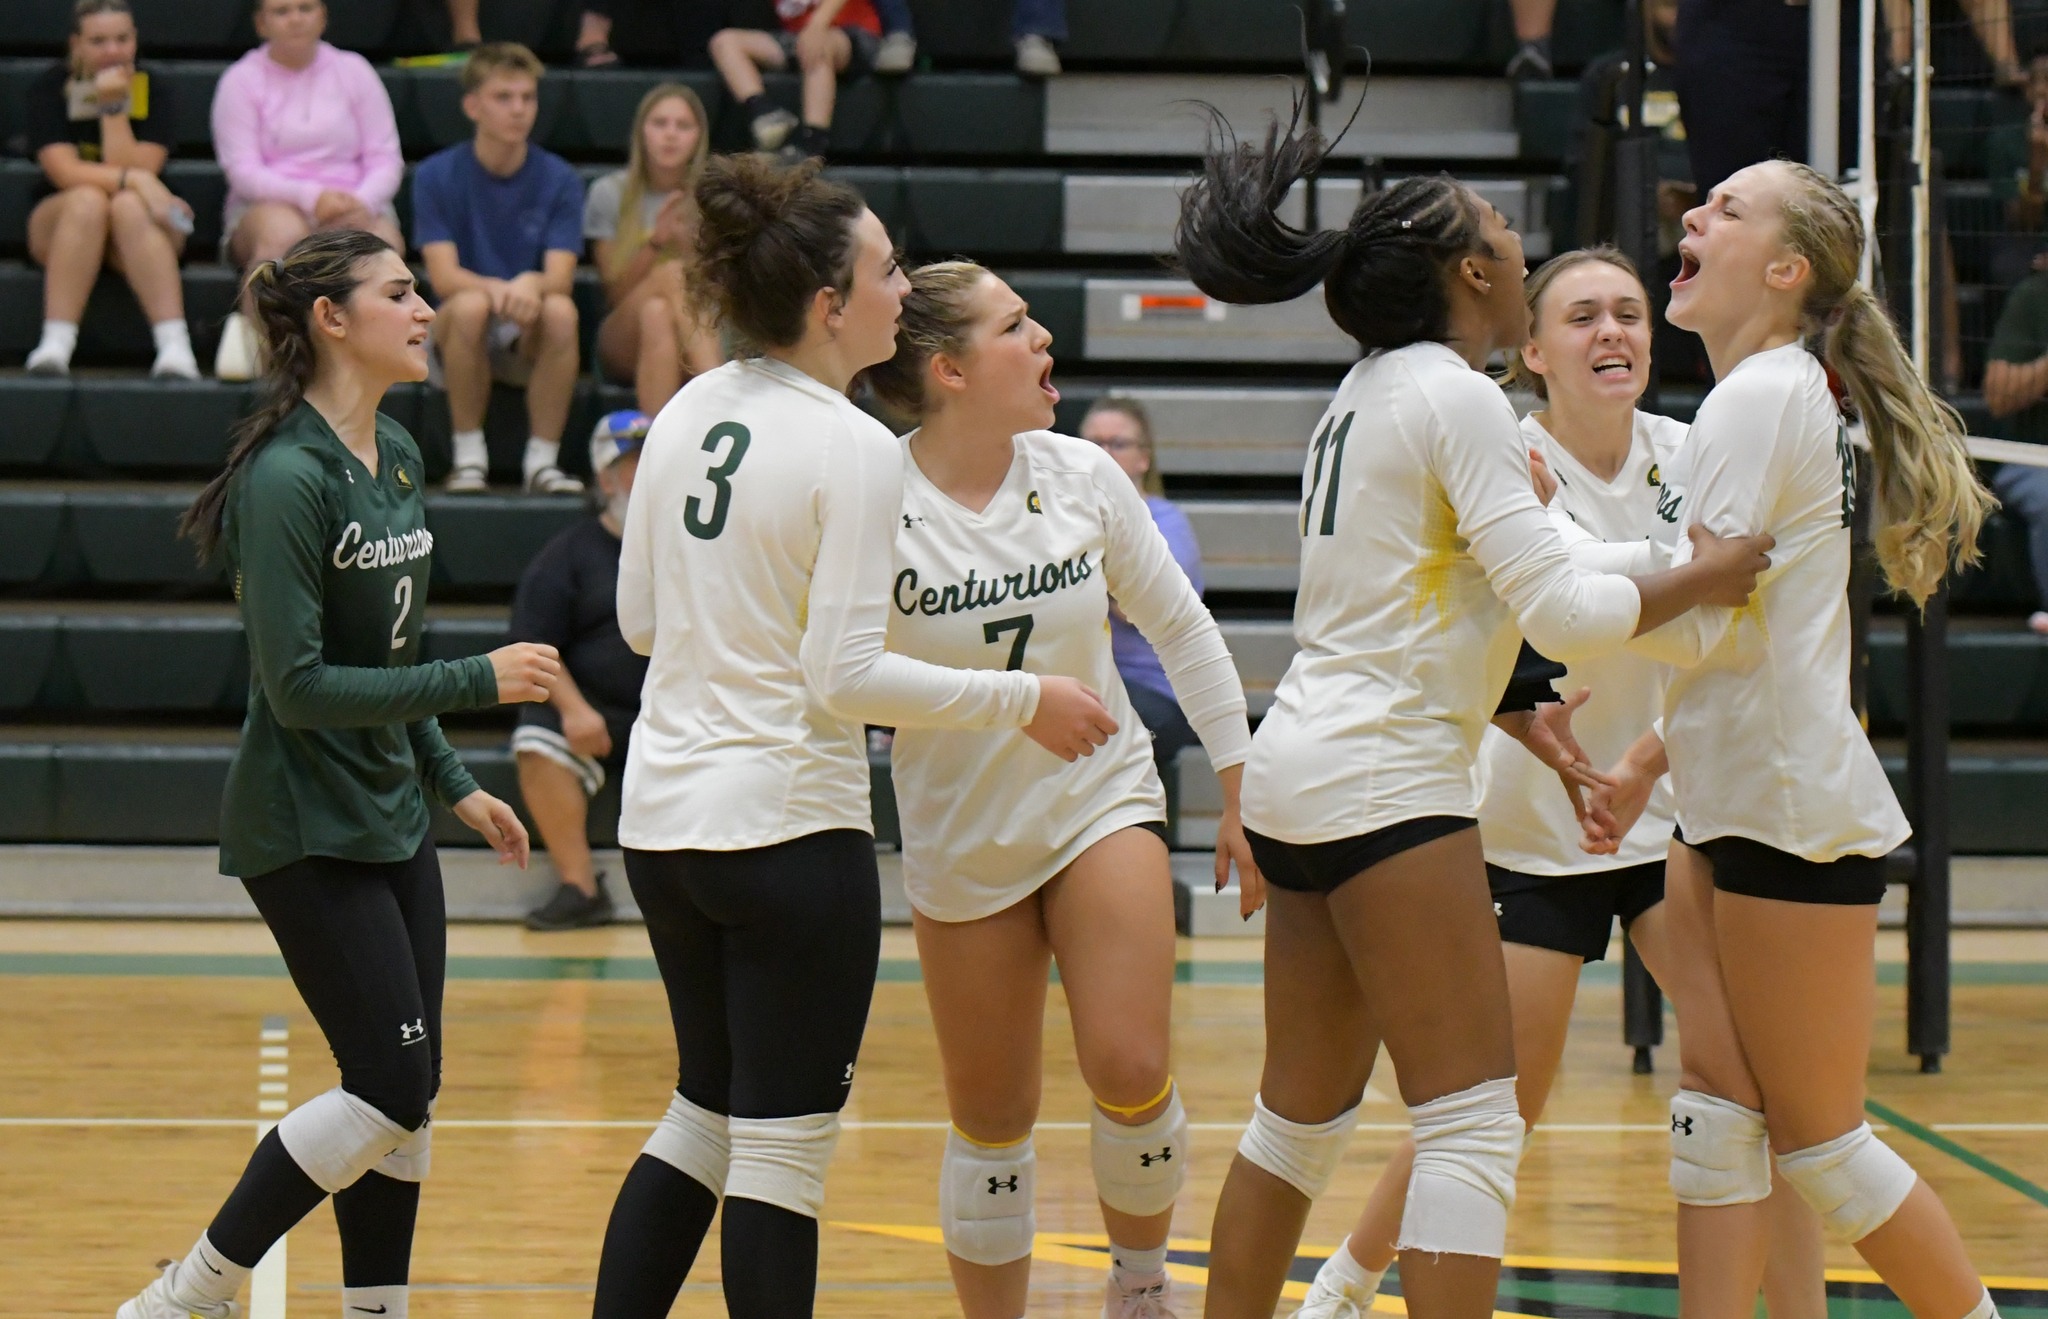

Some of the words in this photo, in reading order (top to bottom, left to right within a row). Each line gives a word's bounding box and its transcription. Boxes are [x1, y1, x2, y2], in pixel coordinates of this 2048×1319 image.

[683, 421, 751, 540] 3
[1303, 410, 1356, 537] 11
[391, 575, 413, 650] 2
[893, 550, 1093, 616] Centurions
[983, 613, 1035, 672] 7
